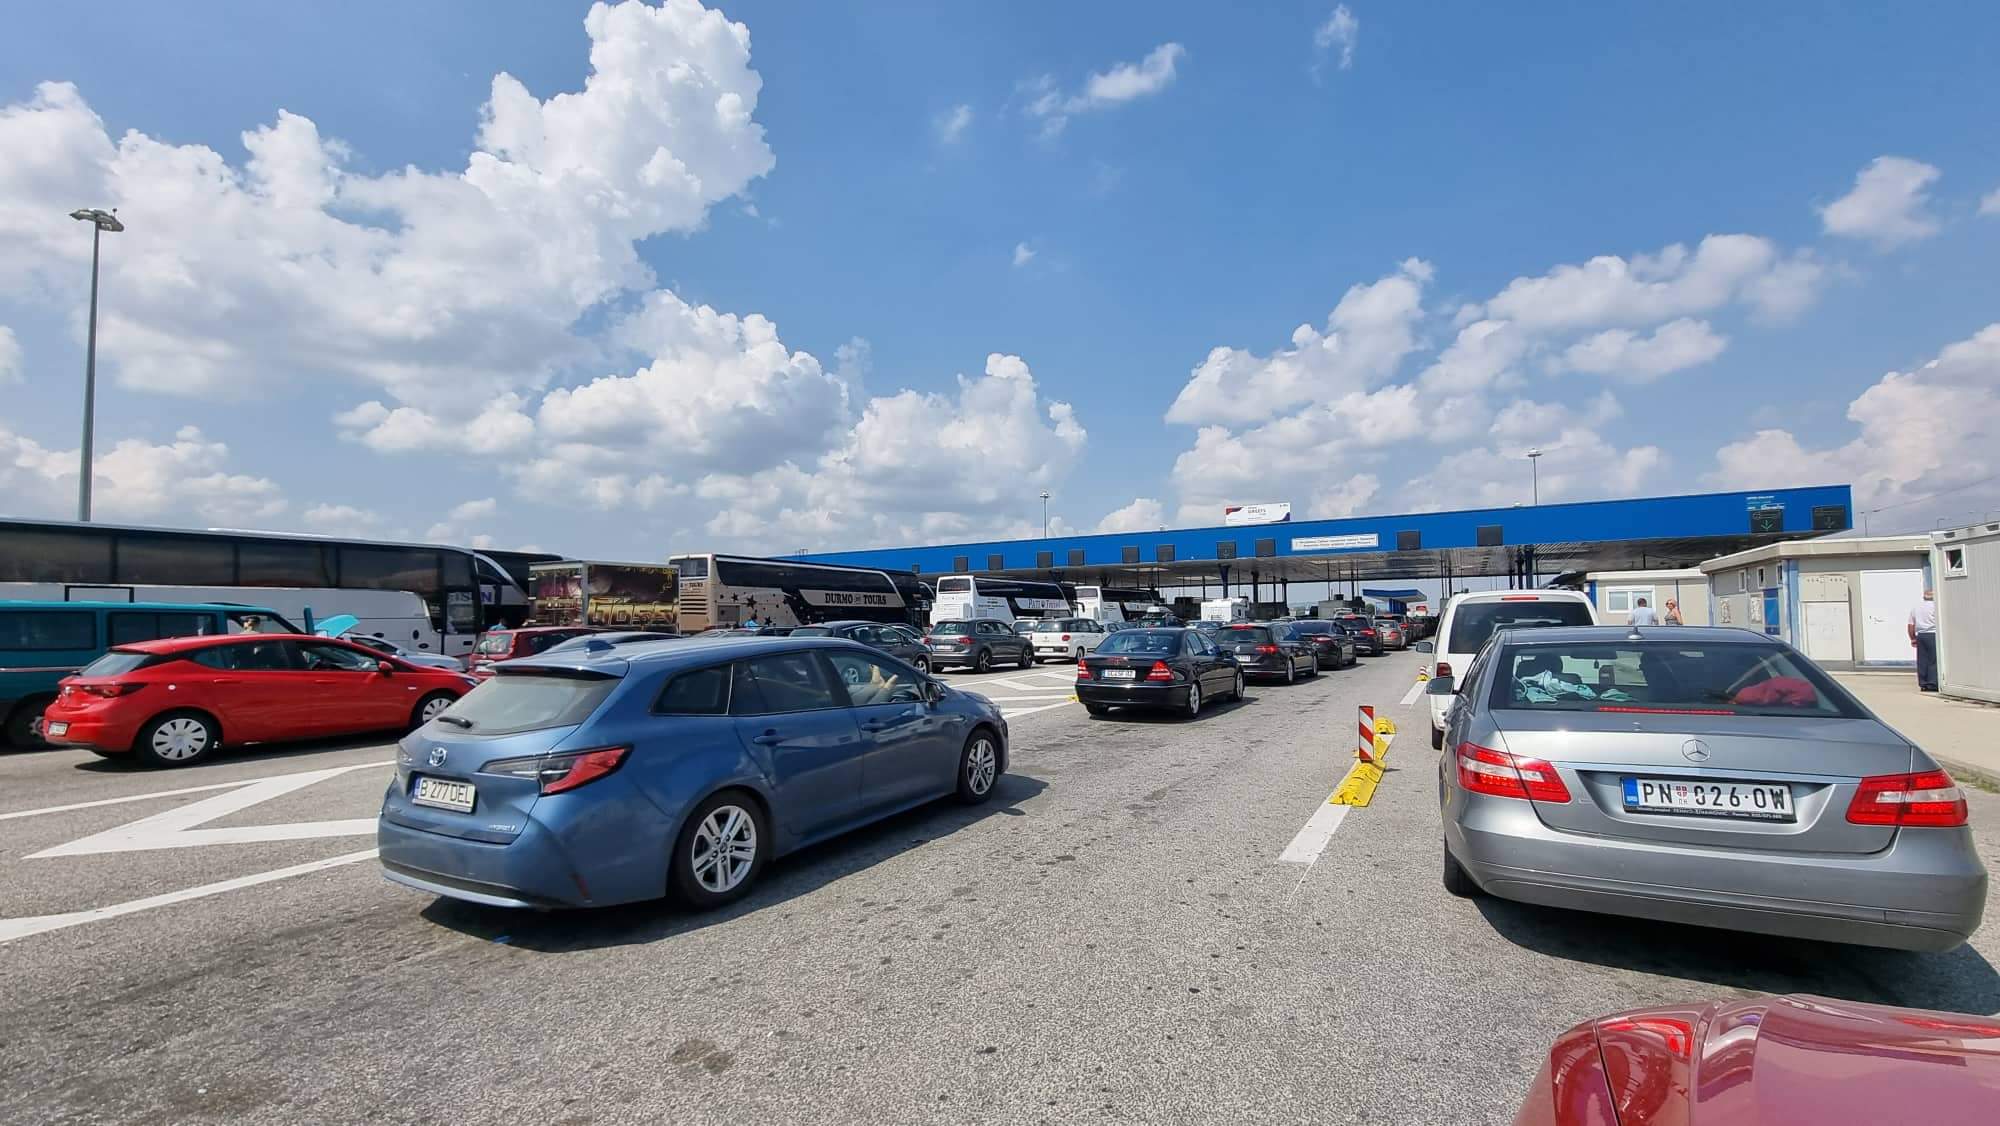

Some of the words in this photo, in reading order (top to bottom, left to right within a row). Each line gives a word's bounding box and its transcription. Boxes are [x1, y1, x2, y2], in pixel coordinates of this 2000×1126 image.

[824, 592, 854, 605] DURMO
[863, 594, 887, 606] TOURS
[420, 780, 428, 797] B
[430, 781, 450, 801] 277
[450, 783, 471, 804] DEL
[1641, 782, 1673, 804] PN
